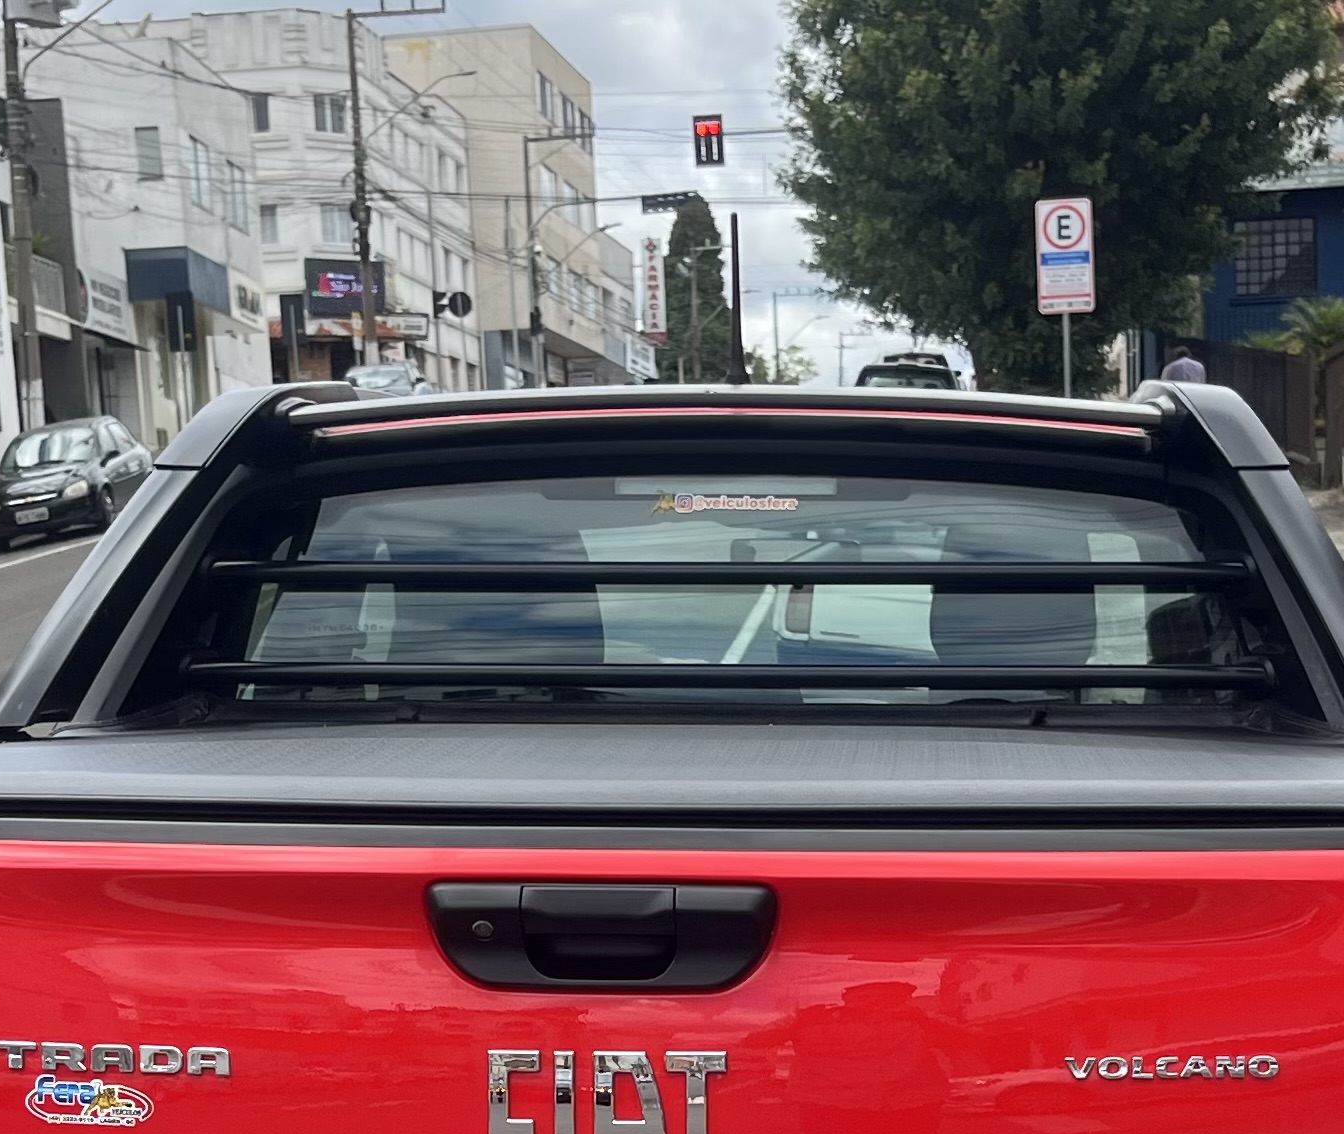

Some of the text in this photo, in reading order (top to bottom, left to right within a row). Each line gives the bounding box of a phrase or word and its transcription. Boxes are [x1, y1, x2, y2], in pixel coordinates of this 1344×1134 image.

[1057, 214, 1071, 239] E
[695, 496, 797, 510] @veiculosfera
[1064, 1055, 1280, 1080] VOLCANO
[36, 1076, 96, 1104] Fera
